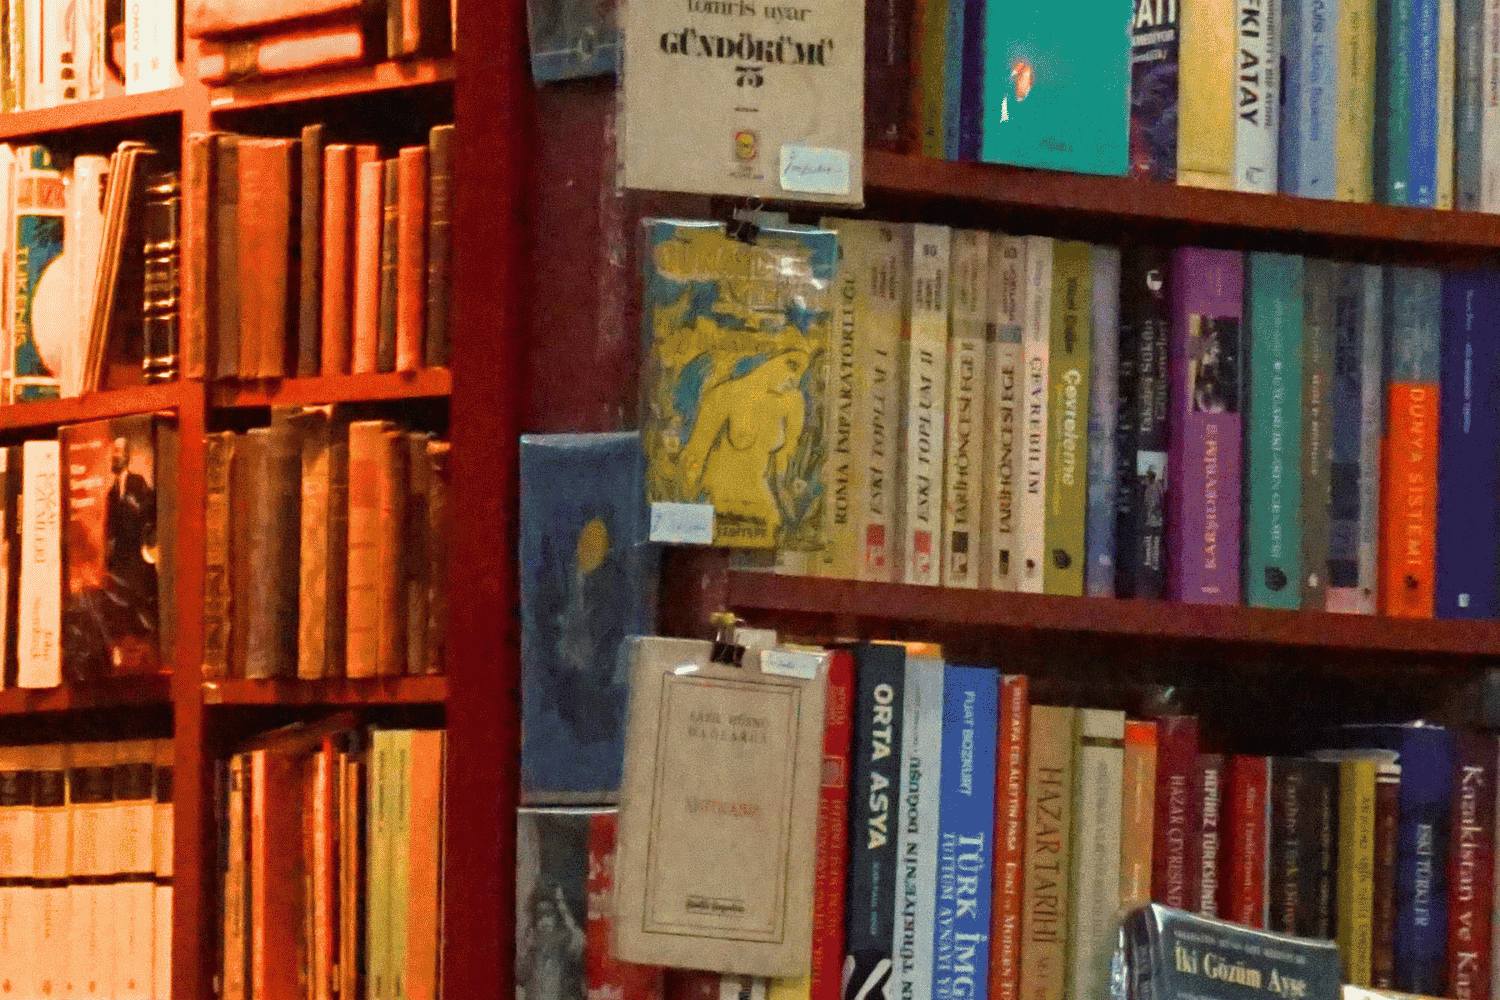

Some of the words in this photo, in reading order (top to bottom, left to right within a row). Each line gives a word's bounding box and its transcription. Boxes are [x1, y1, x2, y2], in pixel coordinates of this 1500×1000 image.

[735, 66, 764, 88] 75
[1239, 48, 1260, 127] ATAY
[962, 356, 974, 392] EGE
[1002, 367, 1014, 401] EGE
[918, 375, 934, 466] TOPLUM
[1027, 357, 1042, 495] ÇEVREBİLİM
[1062, 369, 1081, 486] Çevreleme
[834, 464, 850, 525] ROMA
[869, 467, 885, 515] ESKİ
[954, 397, 971, 526] TARİHÖNCESİ
[917, 475, 932, 523] ESKİ
[873, 682, 893, 761] ORTA
[962, 691, 975, 726] FUAT
[907, 757, 921, 834] DOĞUŞU
[960, 728, 974, 796] BOZKURT
[1204, 769, 1218, 827] HEPİNİZ
[867, 771, 889, 850] ASYA
[1037, 766, 1063, 854] HAZAR
[1169, 775, 1185, 824] HAZAR
[1459, 765, 1484, 902] Kazakistan
[956, 831, 987, 919] TÜRK
[1032, 861, 1062, 943] TARİHİ
[1458, 912, 1473, 941] ve
[1204, 953, 1262, 989] Gözüm
